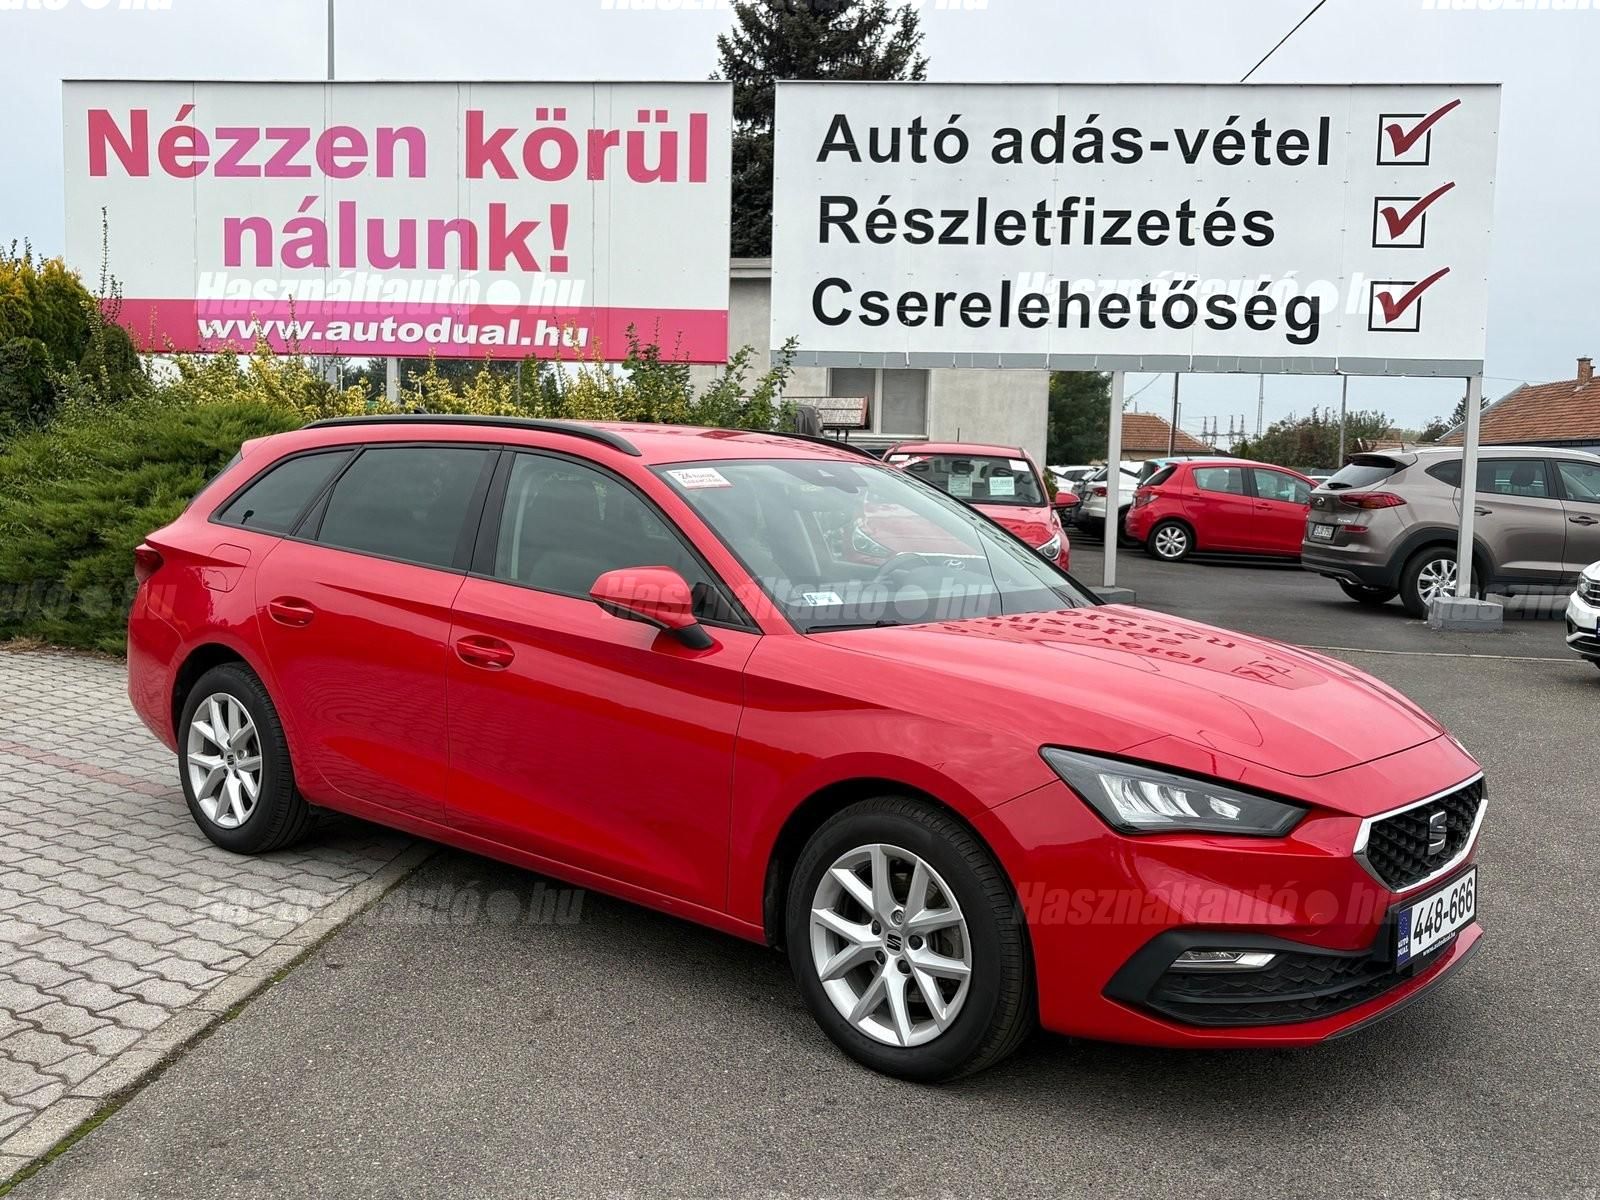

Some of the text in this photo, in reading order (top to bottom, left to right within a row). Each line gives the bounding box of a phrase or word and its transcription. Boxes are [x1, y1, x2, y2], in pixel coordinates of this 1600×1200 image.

[88, 104, 708, 183] Nézzen körül
[817, 114, 1330, 166] Autó adás-vétel
[224, 197, 568, 272] nálunk!
[819, 195, 1275, 247] Részletfizetés
[198, 316, 589, 347] www.autodual.hu
[812, 278, 1320, 345] Cserelehetőség
[1413, 876, 1473, 945] 448-666
